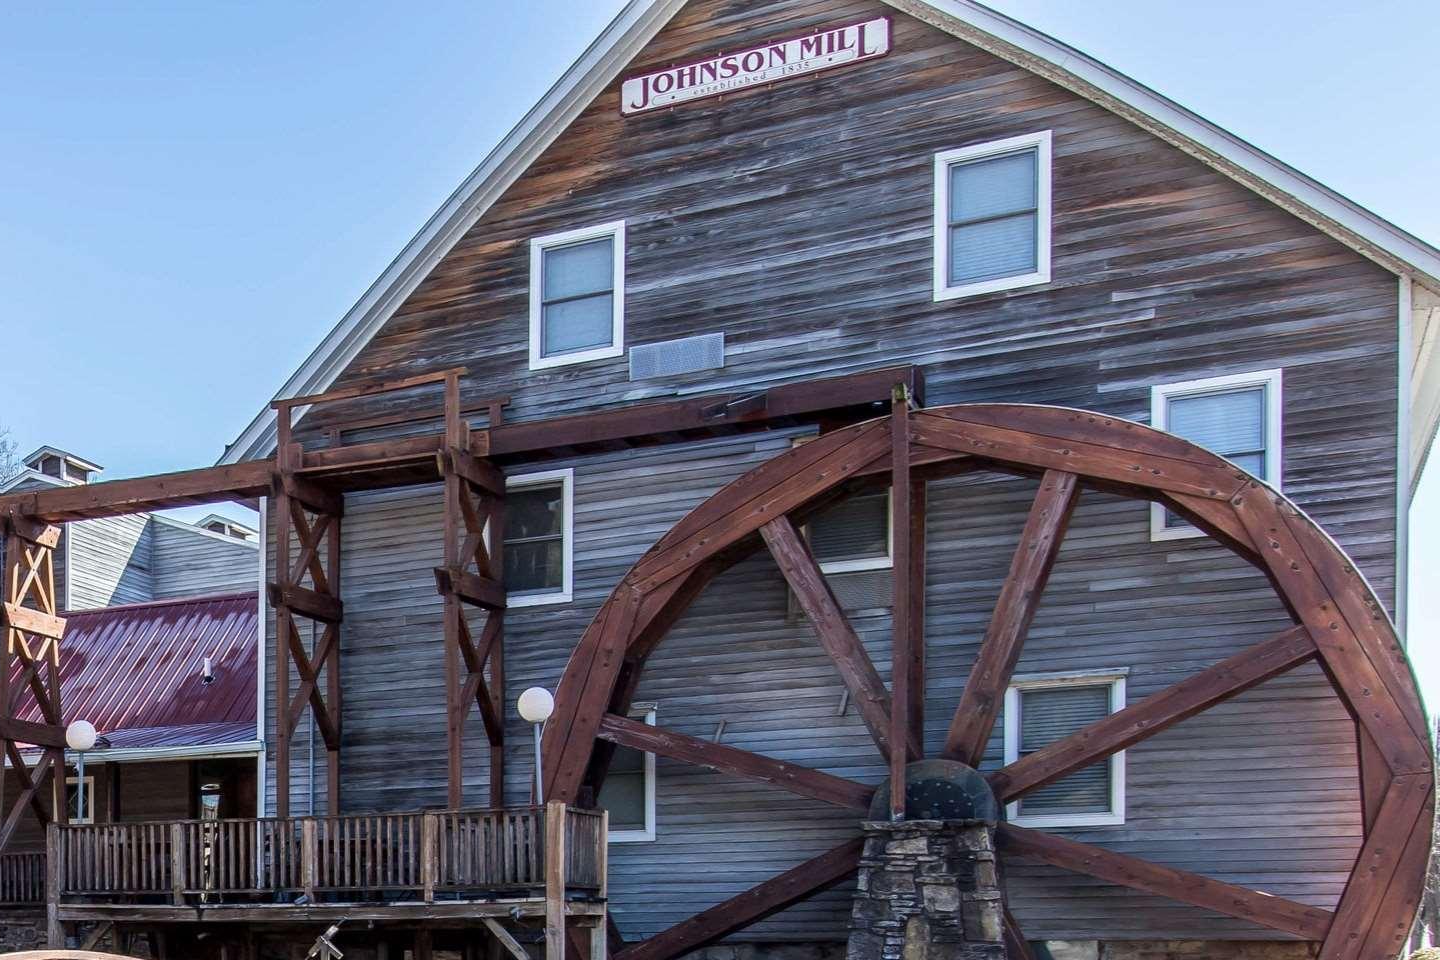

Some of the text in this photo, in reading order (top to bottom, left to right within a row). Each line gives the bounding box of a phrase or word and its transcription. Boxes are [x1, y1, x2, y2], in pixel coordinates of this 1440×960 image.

[631, 25, 878, 109] JOHNSON MILL
[692, 61, 812, 96] established 1835
